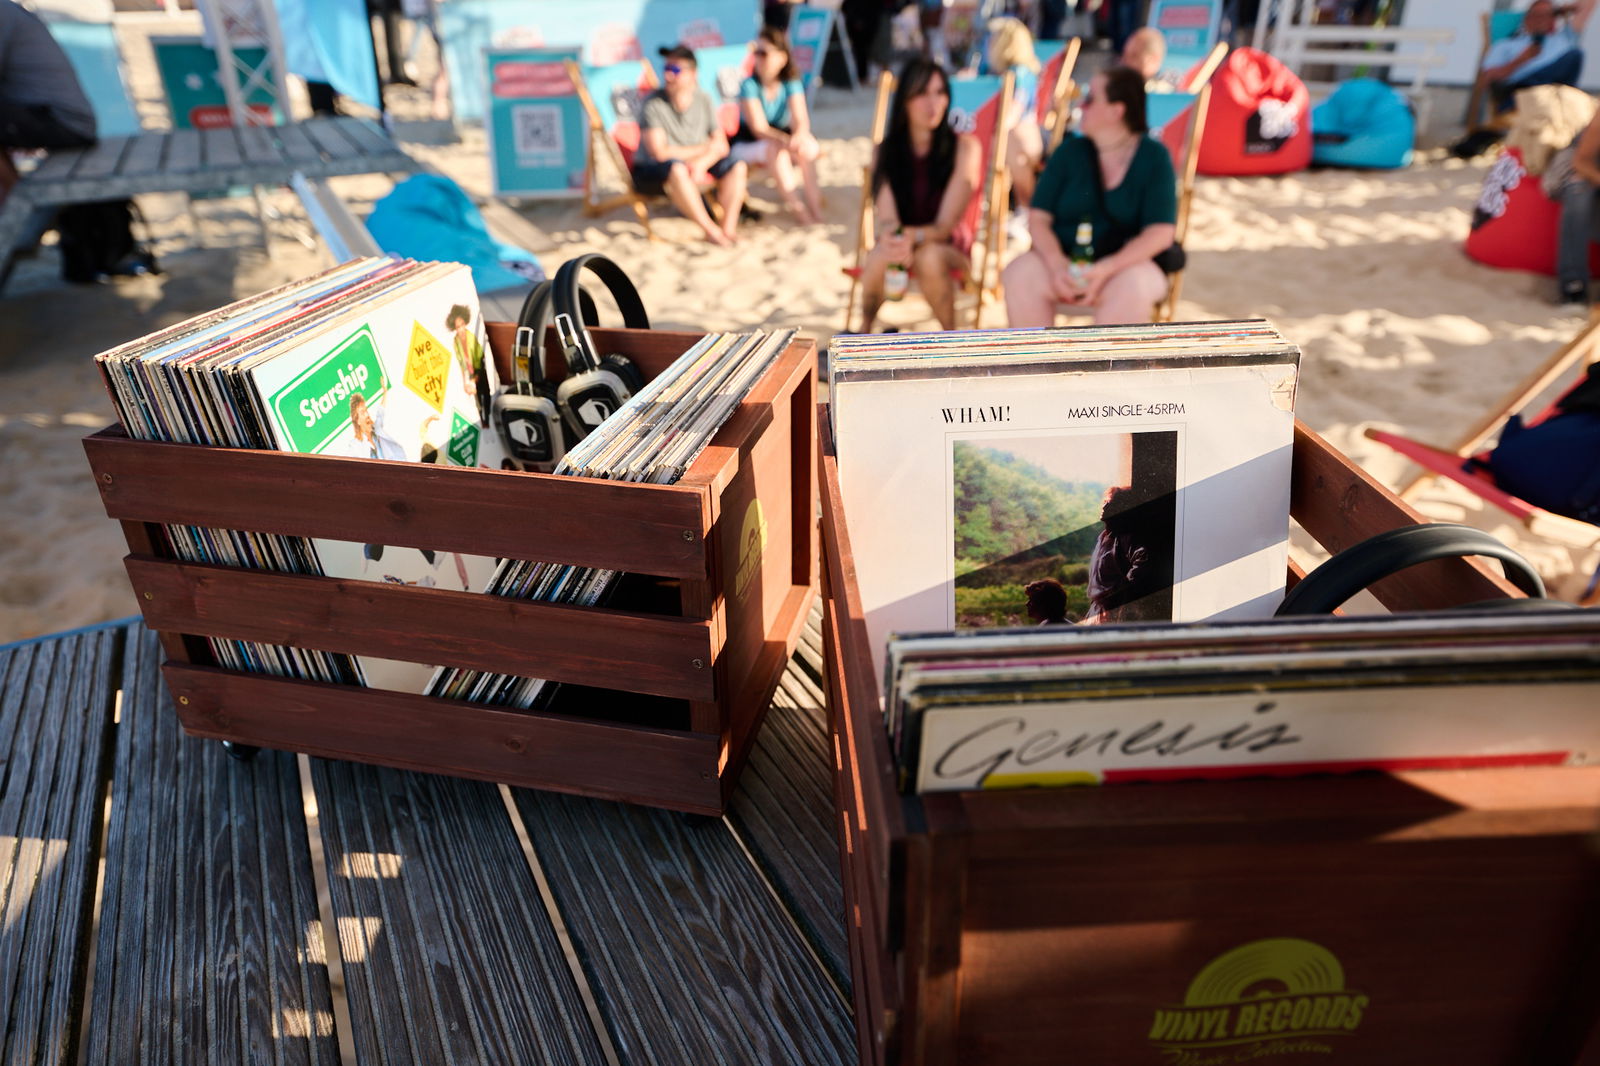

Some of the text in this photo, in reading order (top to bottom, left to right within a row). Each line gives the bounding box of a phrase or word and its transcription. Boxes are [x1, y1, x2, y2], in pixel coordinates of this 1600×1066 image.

[414, 341, 432, 357] we
[424, 374, 443, 394] city
[299, 363, 368, 427] Starship
[942, 406, 1009, 424] WHAM!
[1068, 407, 1100, 419] MAXI
[934, 703, 1301, 785] Genesis
[1148, 994, 1370, 1041] VINYL RECORDS
